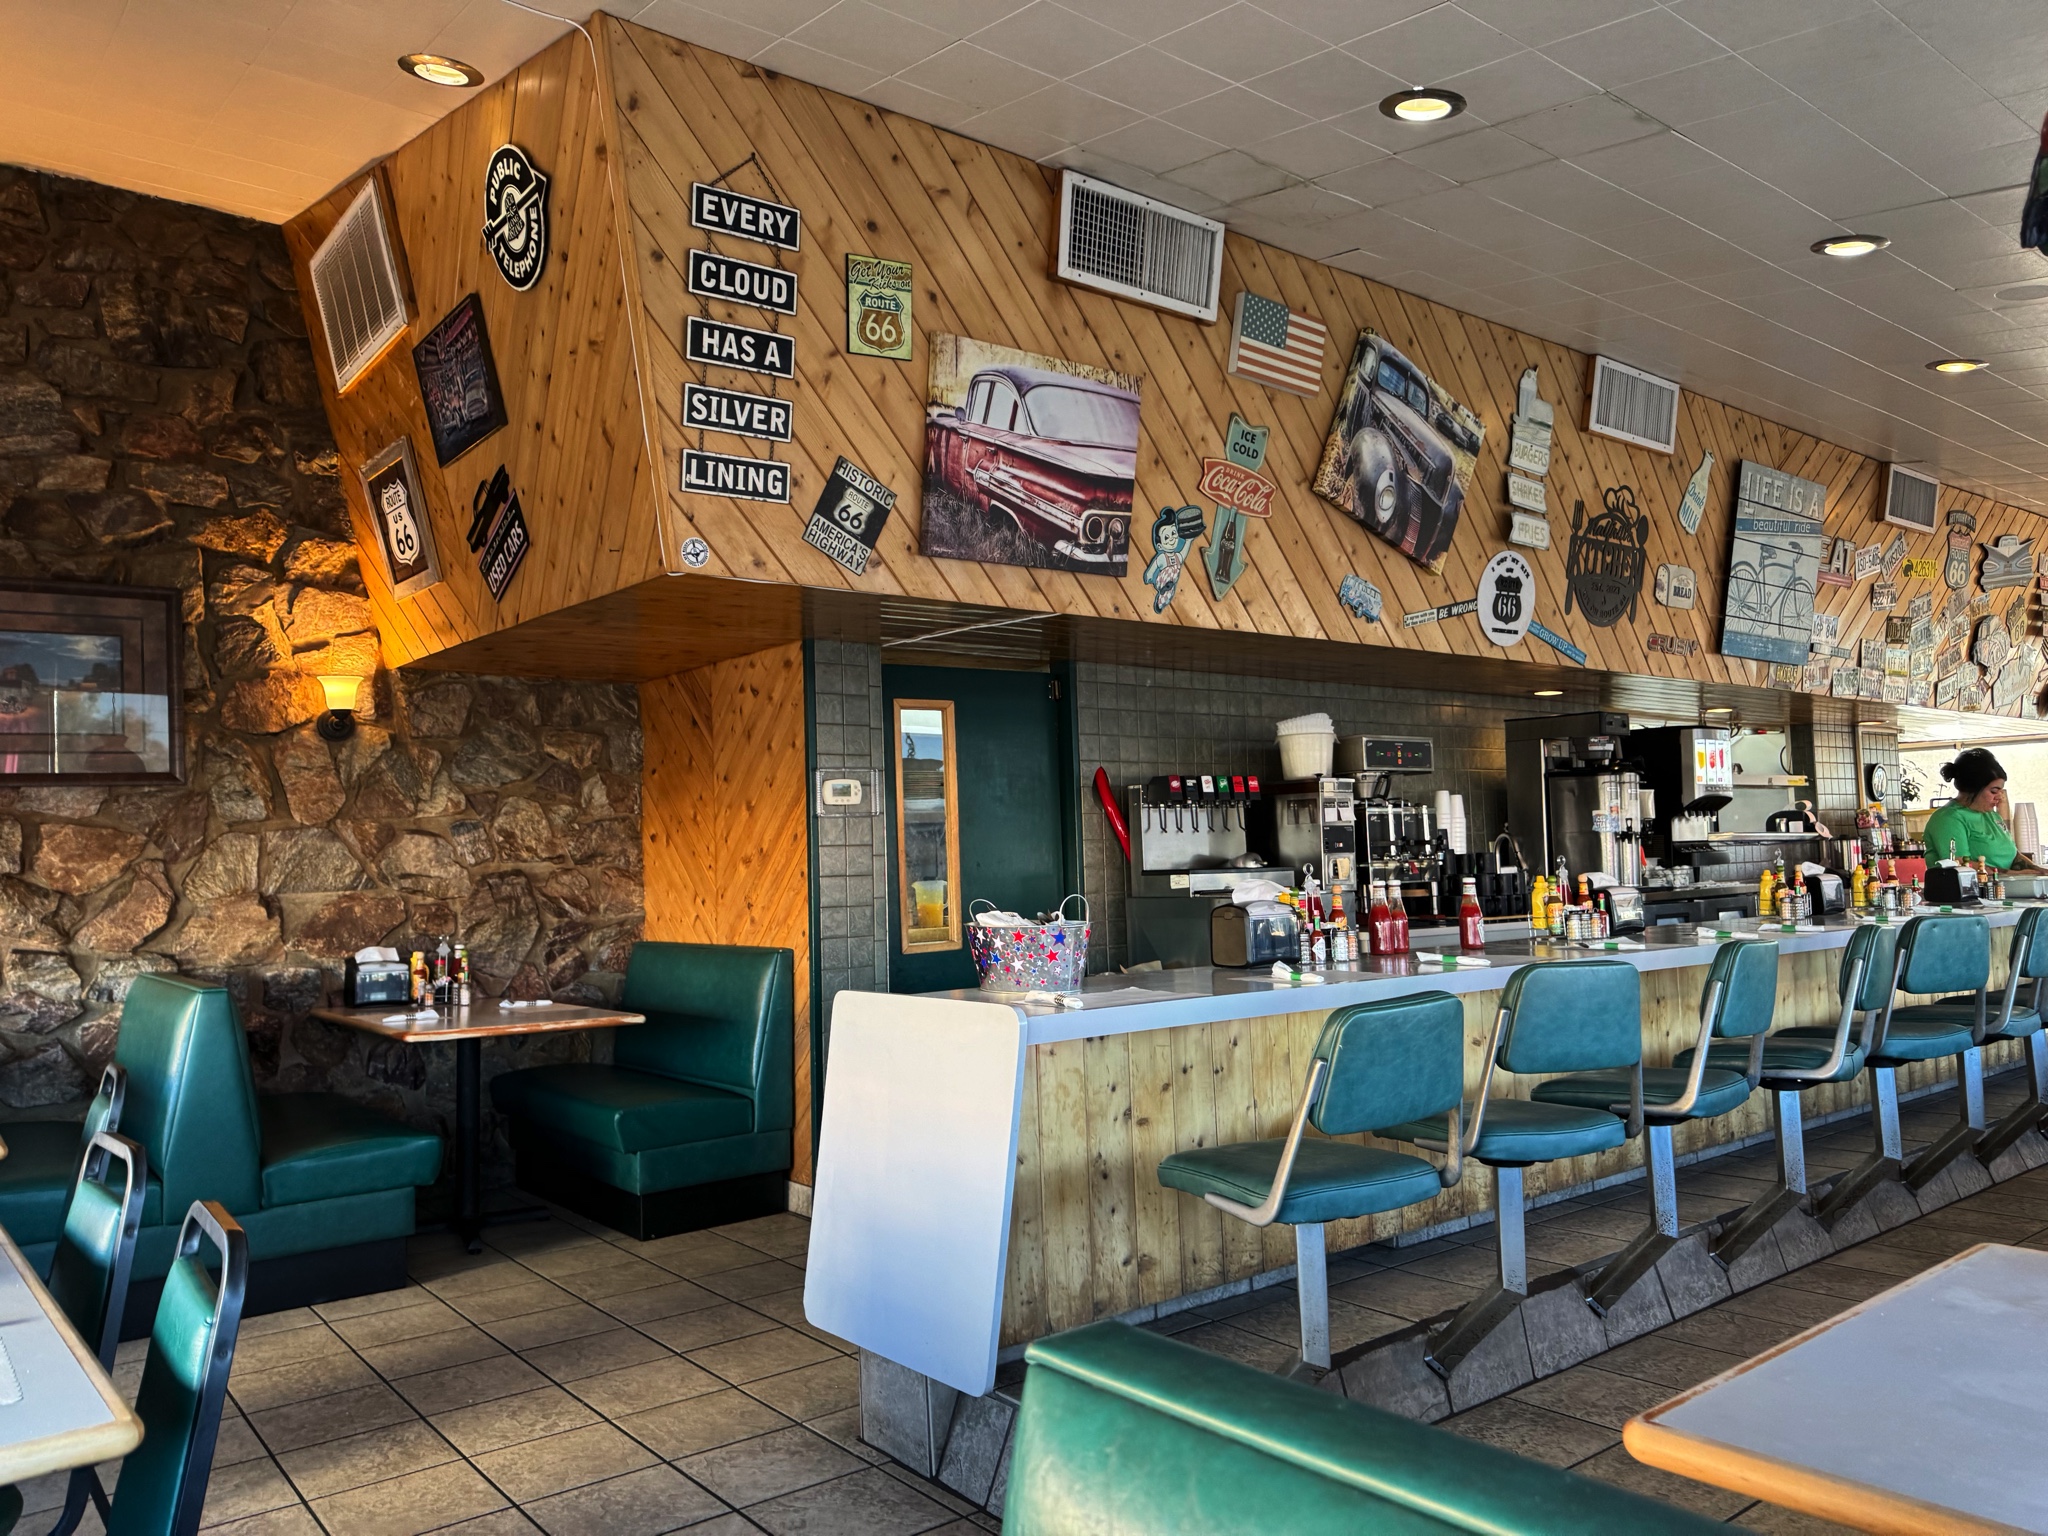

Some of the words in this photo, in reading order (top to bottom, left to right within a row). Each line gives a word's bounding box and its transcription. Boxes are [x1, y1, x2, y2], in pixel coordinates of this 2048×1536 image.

[490, 158, 521, 206] PUBLIC
[702, 193, 792, 240] EVERY
[499, 206, 539, 278] TELEPHONE
[700, 261, 788, 305] CLOUD
[850, 261, 871, 283] Get
[873, 260, 904, 280] Your
[868, 277, 897, 291] Kicks
[900, 279, 911, 288] on
[865, 296, 896, 310] ROUTE
[865, 313, 898, 343] 66
[702, 327, 756, 363] HAS
[764, 340, 781, 368] A
[691, 393, 786, 434] SILVER
[1240, 429, 1257, 444] ICE
[1233, 442, 1259, 459] COLD
[1514, 443, 1548, 467] BURGERS
[688, 458, 783, 497] LINING
[837, 460, 894, 507] HISTORIC
[1226, 467, 1245, 480] DRINK
[385, 489, 402, 509] ROUTE
[847, 490, 871, 510] ROUTE
[1511, 481, 1543, 505] SHAKES
[1687, 481, 1705, 510] Drink
[1743, 472, 1785, 515] LIFE
[1789, 482, 1804, 514] IS
[1808, 490, 1820, 519] A
[392, 511, 403, 524] US
[838, 504, 864, 530] 66
[1681, 500, 1700, 532] MILK
[1753, 514, 1791, 533] beautiful
[1794, 520, 1811, 533] ride
[395, 524, 414, 556] 66
[811, 517, 869, 561] AMERICA'S
[1518, 522, 1545, 543] FRIES
[488, 552, 506, 594] USED
[503, 520, 524, 563] CARS
[807, 528, 864, 572] HIGHWAY
[1568, 536, 1638, 585] KITCHEN
[1819, 535, 1856, 577] EAT
[1950, 547, 1969, 560] ROUTE
[1949, 561, 1966, 585] 66
[1673, 585, 1692, 600] BREAD
[1438, 607, 1449, 620] BE
[1497, 596, 1516, 618] 66
[1540, 628, 1559, 646] GROW
[1558, 638, 1568, 652] UP
[2014, 620, 2025, 642] 66
